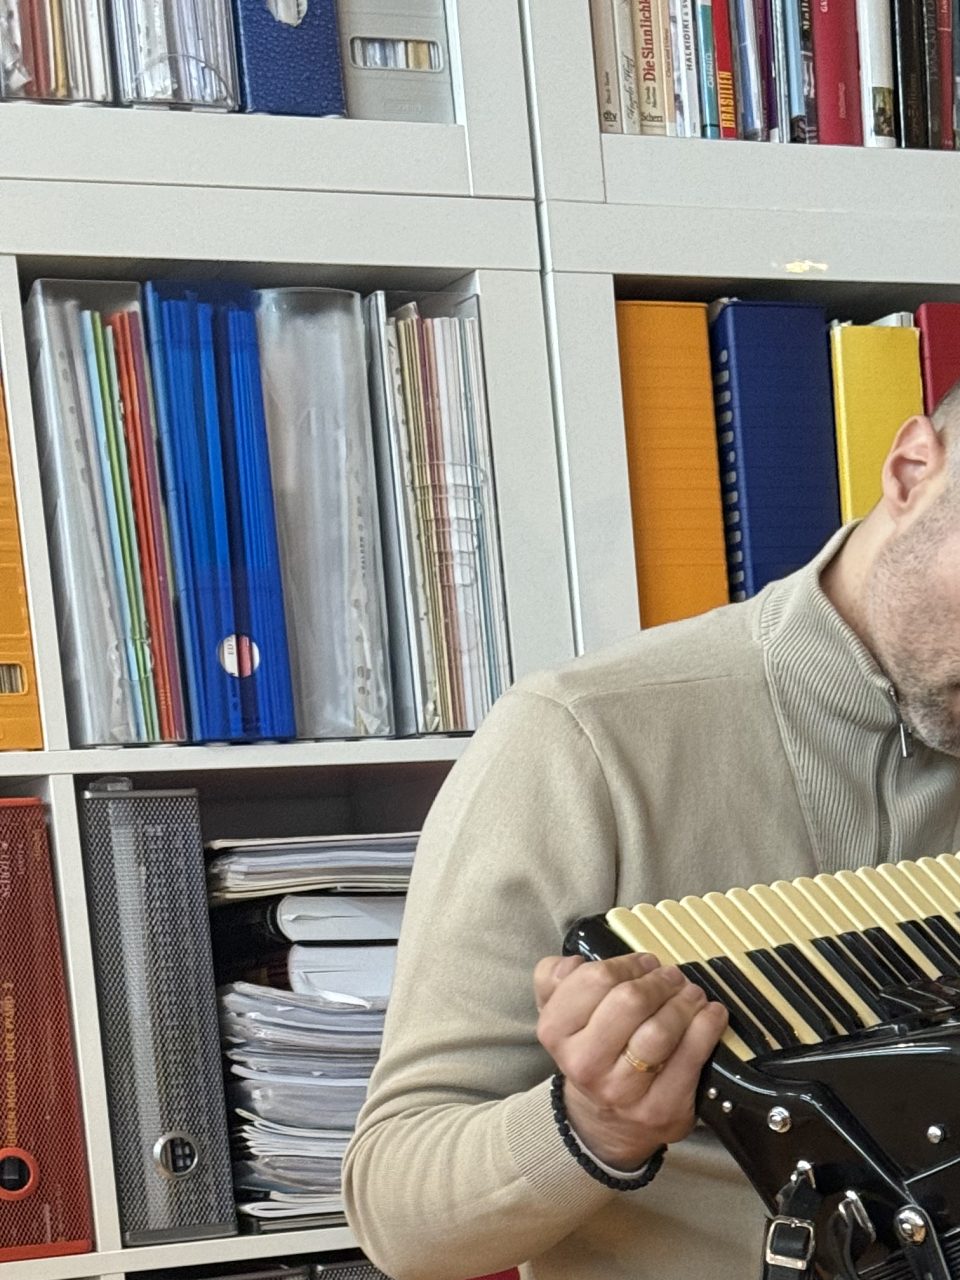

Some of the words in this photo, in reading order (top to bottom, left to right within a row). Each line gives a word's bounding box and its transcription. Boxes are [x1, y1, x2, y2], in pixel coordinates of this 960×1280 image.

[682, 19, 693, 71] HALKIDIKI
[642, 61, 656, 83] Die
[718, 70, 735, 128] BRASILIEN
